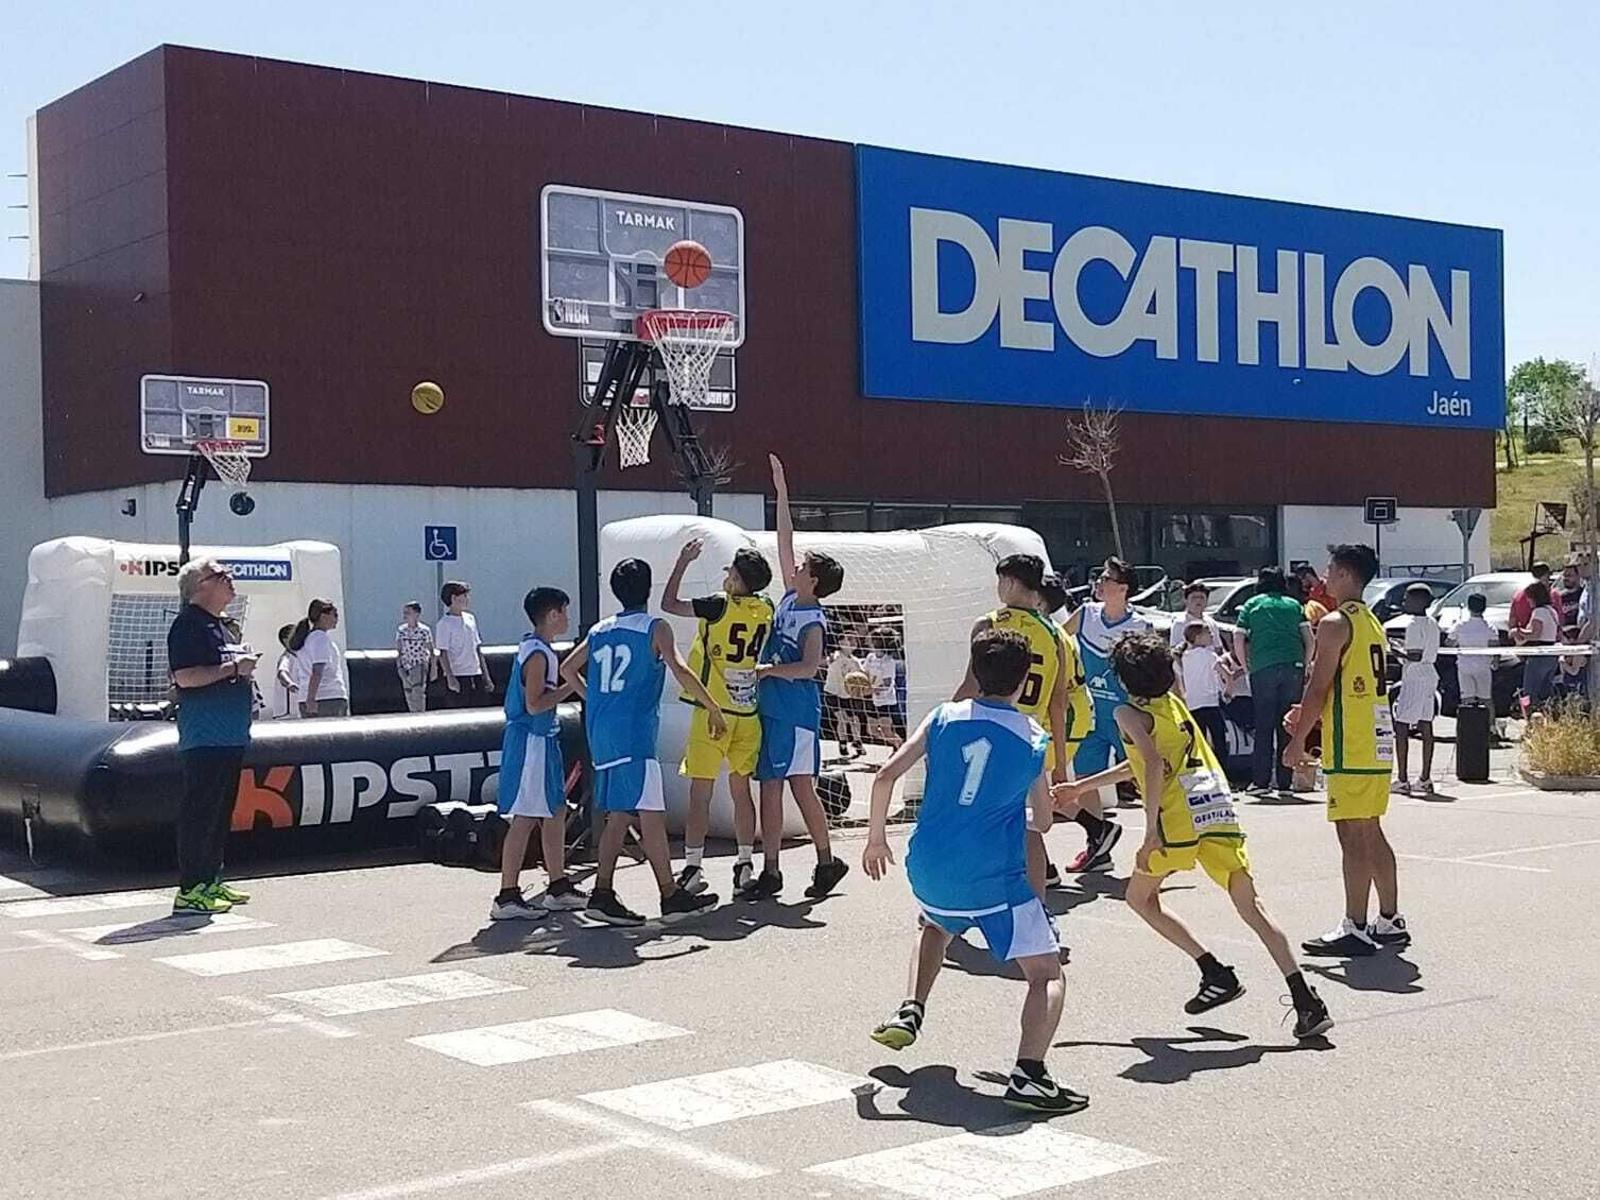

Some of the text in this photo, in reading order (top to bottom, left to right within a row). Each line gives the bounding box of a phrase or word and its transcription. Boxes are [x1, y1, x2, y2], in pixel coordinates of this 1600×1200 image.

[616, 210, 676, 231] TARMAK
[909, 206, 1471, 380] DECATHLON
[563, 298, 590, 325] NBA
[186, 386, 225, 396] TARMAK
[1427, 391, 1472, 417] Jaén
[128, 560, 180, 576] KIPS
[223, 563, 288, 578] ECATHLON
[725, 622, 767, 663] 54
[592, 644, 632, 693] 12
[1370, 643, 1387, 697] 9
[1180, 720, 1204, 768] 2
[958, 736, 993, 806] 1
